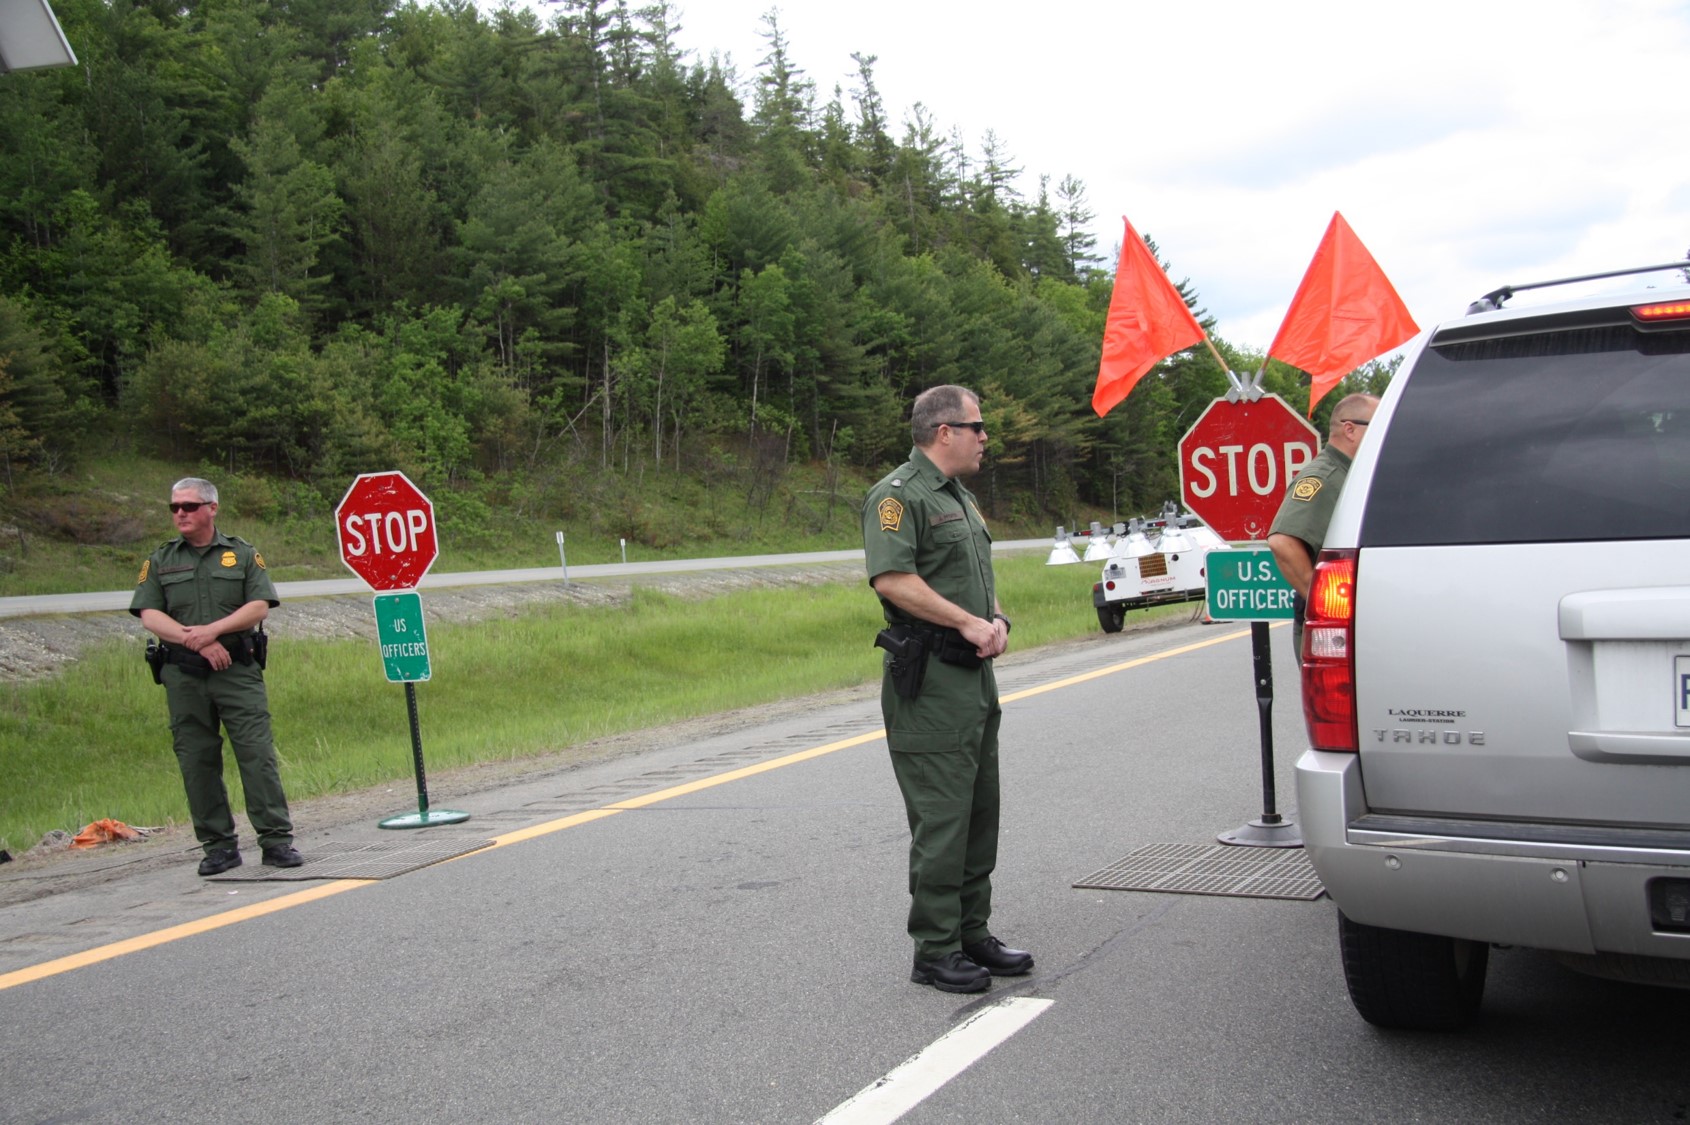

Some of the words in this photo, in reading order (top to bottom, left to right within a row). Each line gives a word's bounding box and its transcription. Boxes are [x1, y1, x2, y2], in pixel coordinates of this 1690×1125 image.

[1190, 442, 1313, 498] STOP
[345, 509, 428, 557] STOP
[1237, 560, 1277, 582] U.S.
[393, 618, 407, 633] US
[382, 642, 426, 659] OFFICERS
[1388, 708, 1467, 718] LAQUERRE
[1372, 728, 1486, 746] TAHOE
